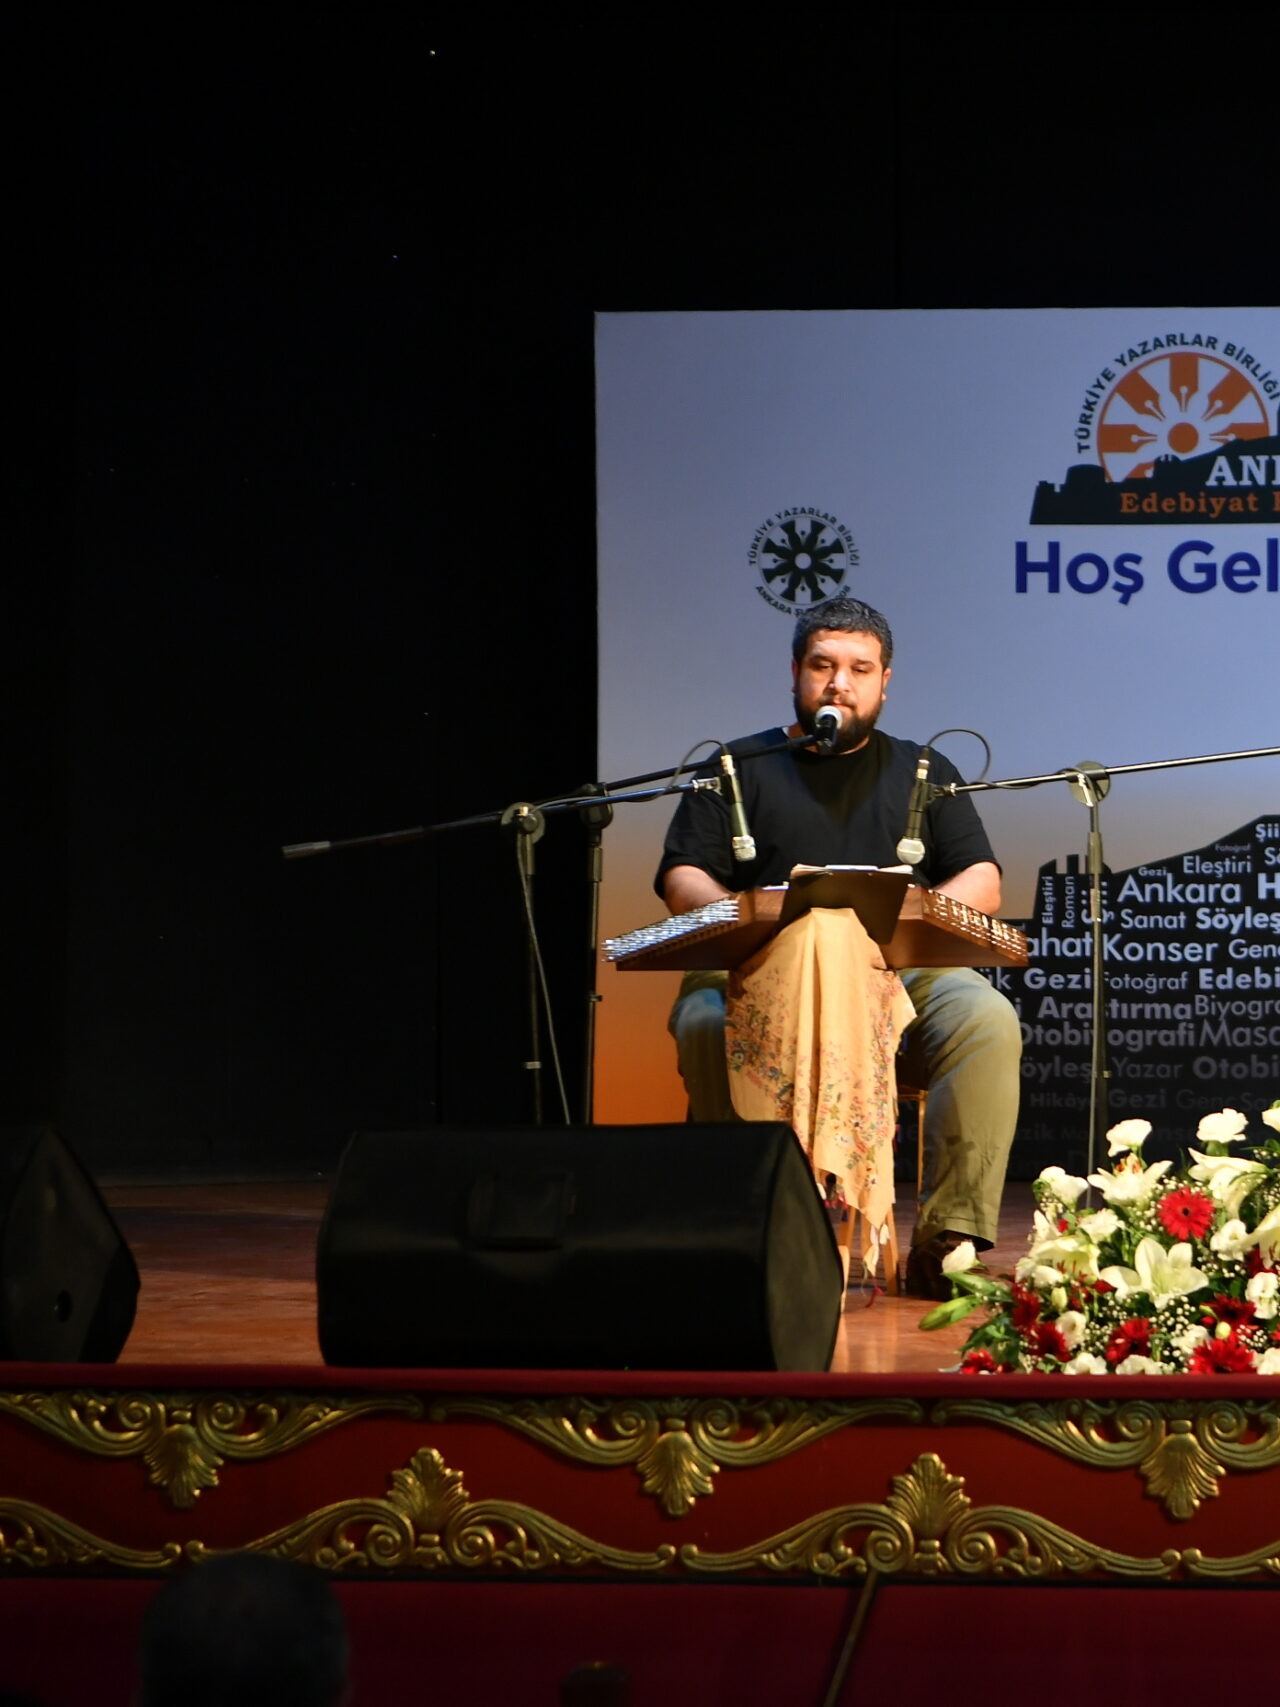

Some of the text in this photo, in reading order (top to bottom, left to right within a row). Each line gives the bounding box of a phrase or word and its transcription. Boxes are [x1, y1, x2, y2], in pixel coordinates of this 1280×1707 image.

[1077, 367, 1115, 454] TÜRKİYE
[1114, 333, 1217, 368] YAZARLAR
[1120, 492, 1258, 517] Edebiyat
[747, 507, 860, 566] TÜRKİYE YAZARLAR BİRLİĞİ
[1015, 541, 1144, 604] Hoş
[756, 585, 792, 615] ANKARA
[1138, 866, 1168, 877] Gezi
[1184, 856, 1251, 878] Eleştiri
[1042, 876, 1056, 924] Eleştiri
[1061, 876, 1075, 928] Roman
[1117, 873, 1242, 904] Ankara
[1121, 909, 1186, 928] Sanat
[1103, 934, 1218, 962] Konser
[1024, 968, 1091, 989] Gezi
[1104, 971, 1188, 994] otoğraf
[1037, 996, 1192, 1020] Aratırma
[1021, 1021, 1195, 1052] Otobiografi
[1112, 1057, 1183, 1078] Yazar
[1108, 1088, 1166, 1108] Gezi
